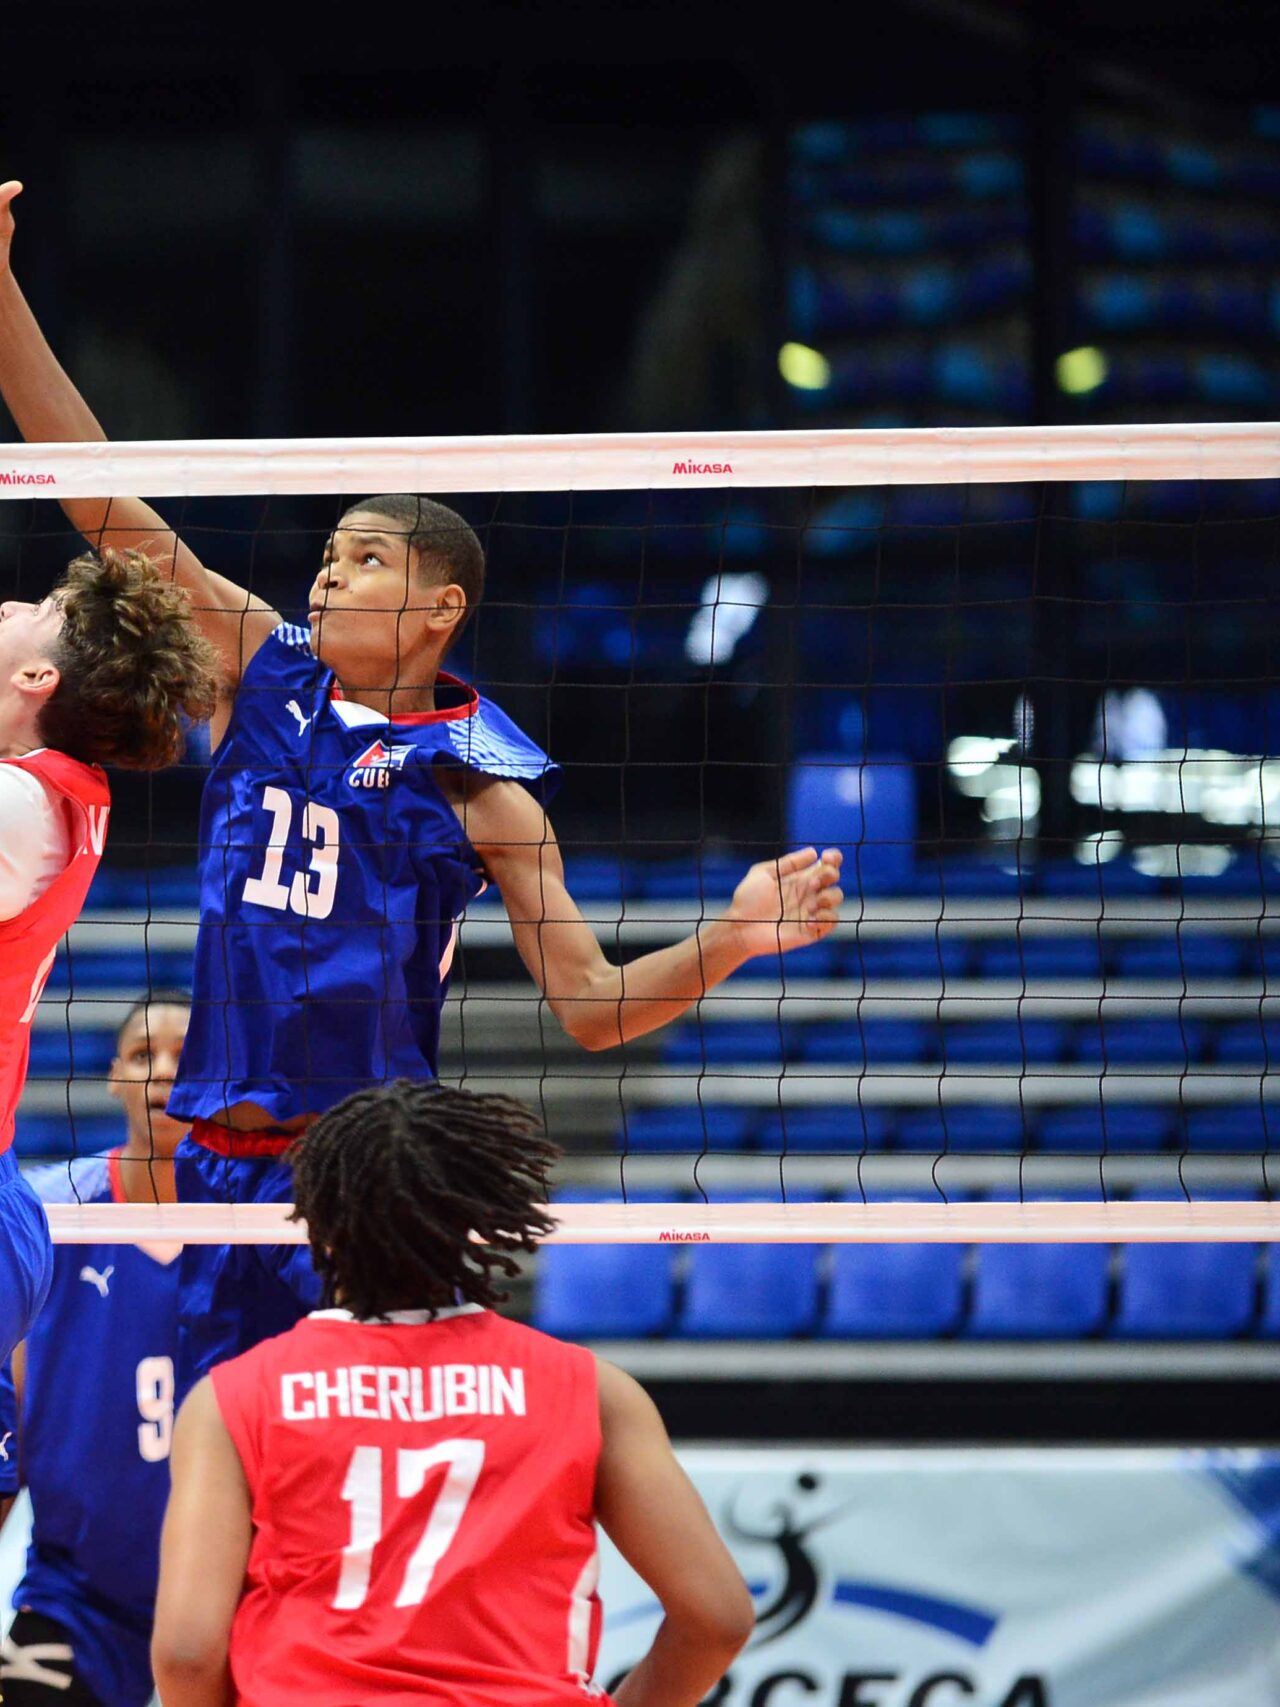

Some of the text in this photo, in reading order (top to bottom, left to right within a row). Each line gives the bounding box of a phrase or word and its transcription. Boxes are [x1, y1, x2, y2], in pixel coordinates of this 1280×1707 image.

[348, 768, 390, 788] CUB
[242, 786, 339, 920] 13
[136, 1355, 174, 1462] 9
[281, 1364, 526, 1422] CHERUBIN
[330, 1438, 486, 1609] 17
